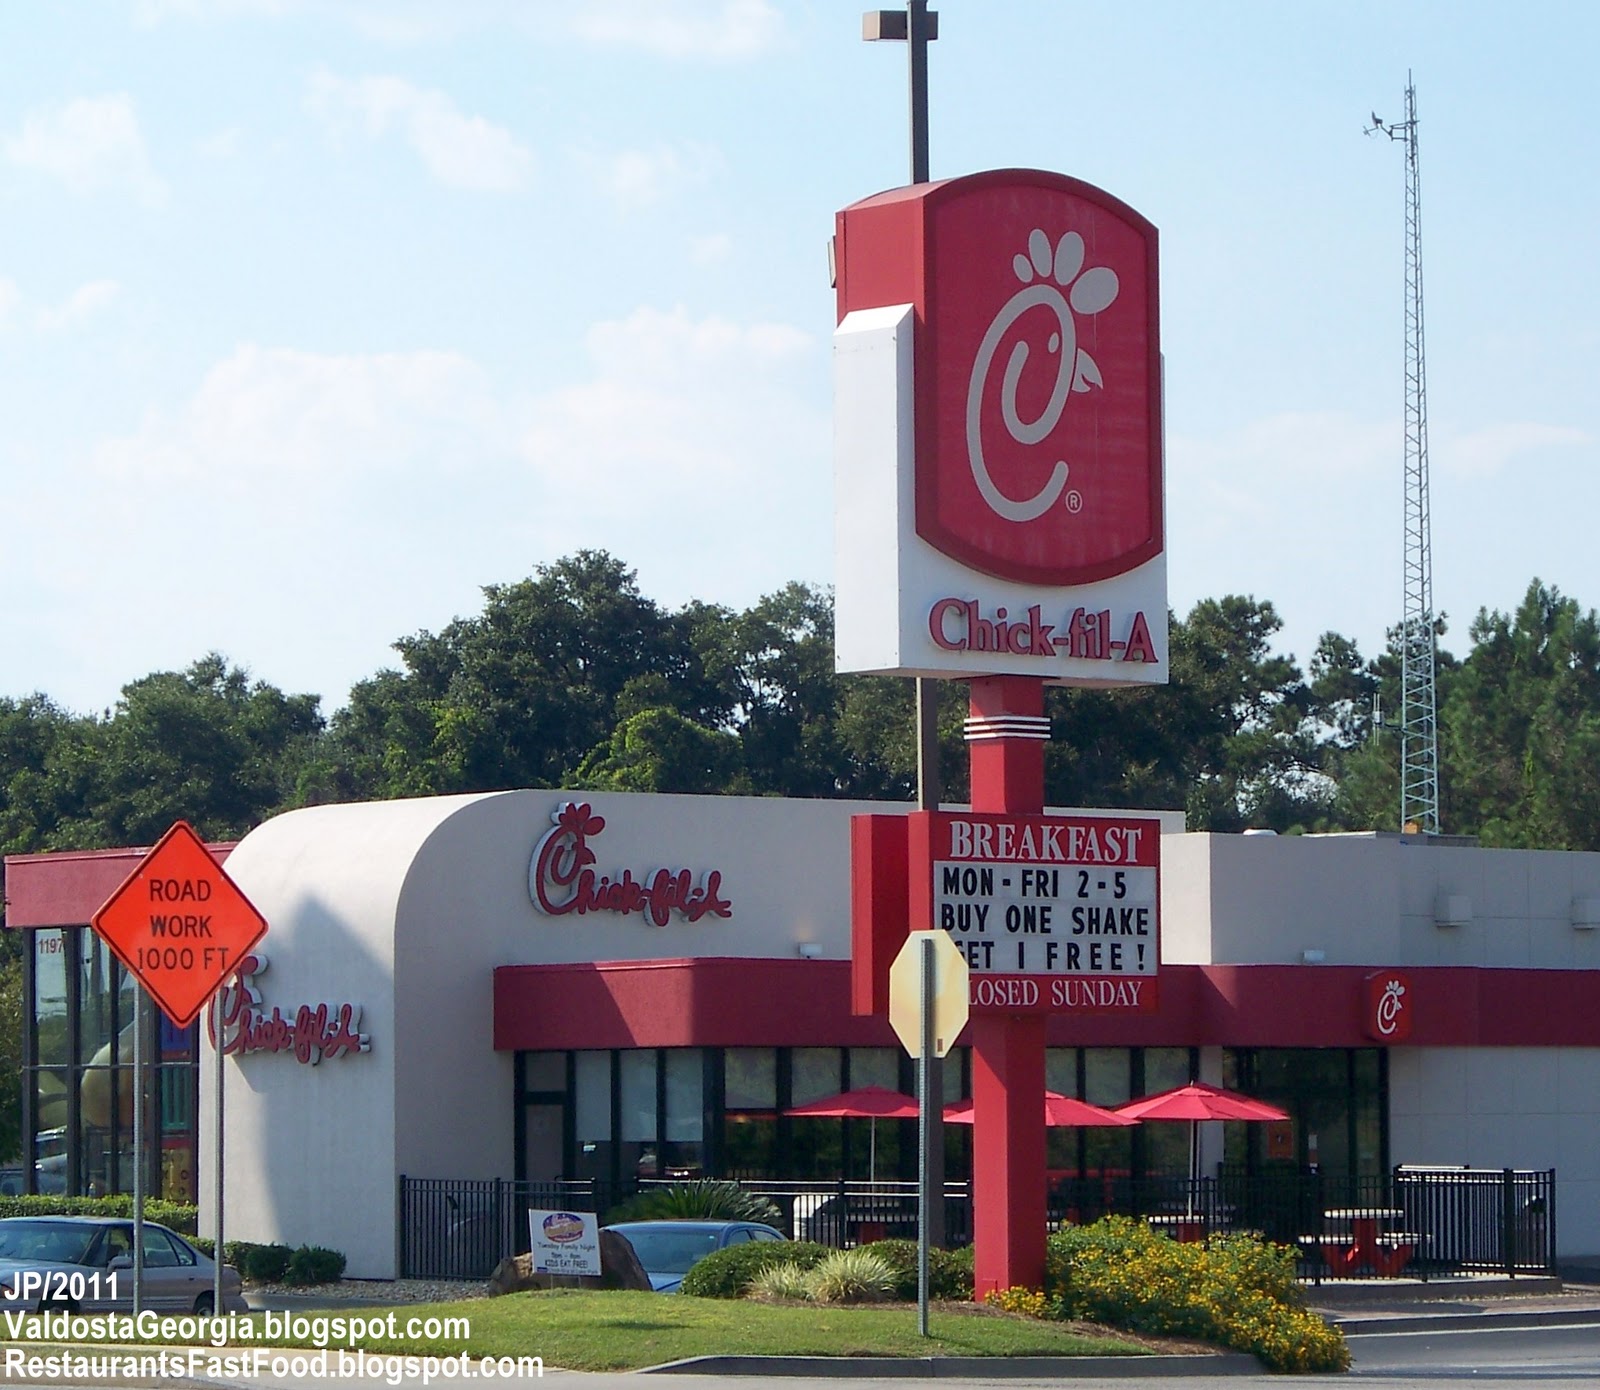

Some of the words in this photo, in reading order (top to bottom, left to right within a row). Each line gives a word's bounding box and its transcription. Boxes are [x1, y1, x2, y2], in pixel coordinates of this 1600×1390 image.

[929, 597, 1159, 664] Chick-fil-A
[950, 820, 1142, 863] BREAKFAST
[149, 879, 212, 902] ROAD
[149, 914, 213, 938] WORK
[941, 903, 990, 933] BUY
[1005, 904, 1052, 934] ONE
[1071, 906, 1149, 937] SHAKE
[39, 938, 64, 954] 1197
[137, 947, 194, 970] 1000
[203, 947, 230, 970] FT
[968, 979, 1040, 1006] LOSED
[1051, 979, 1142, 1007] SUNDAY
